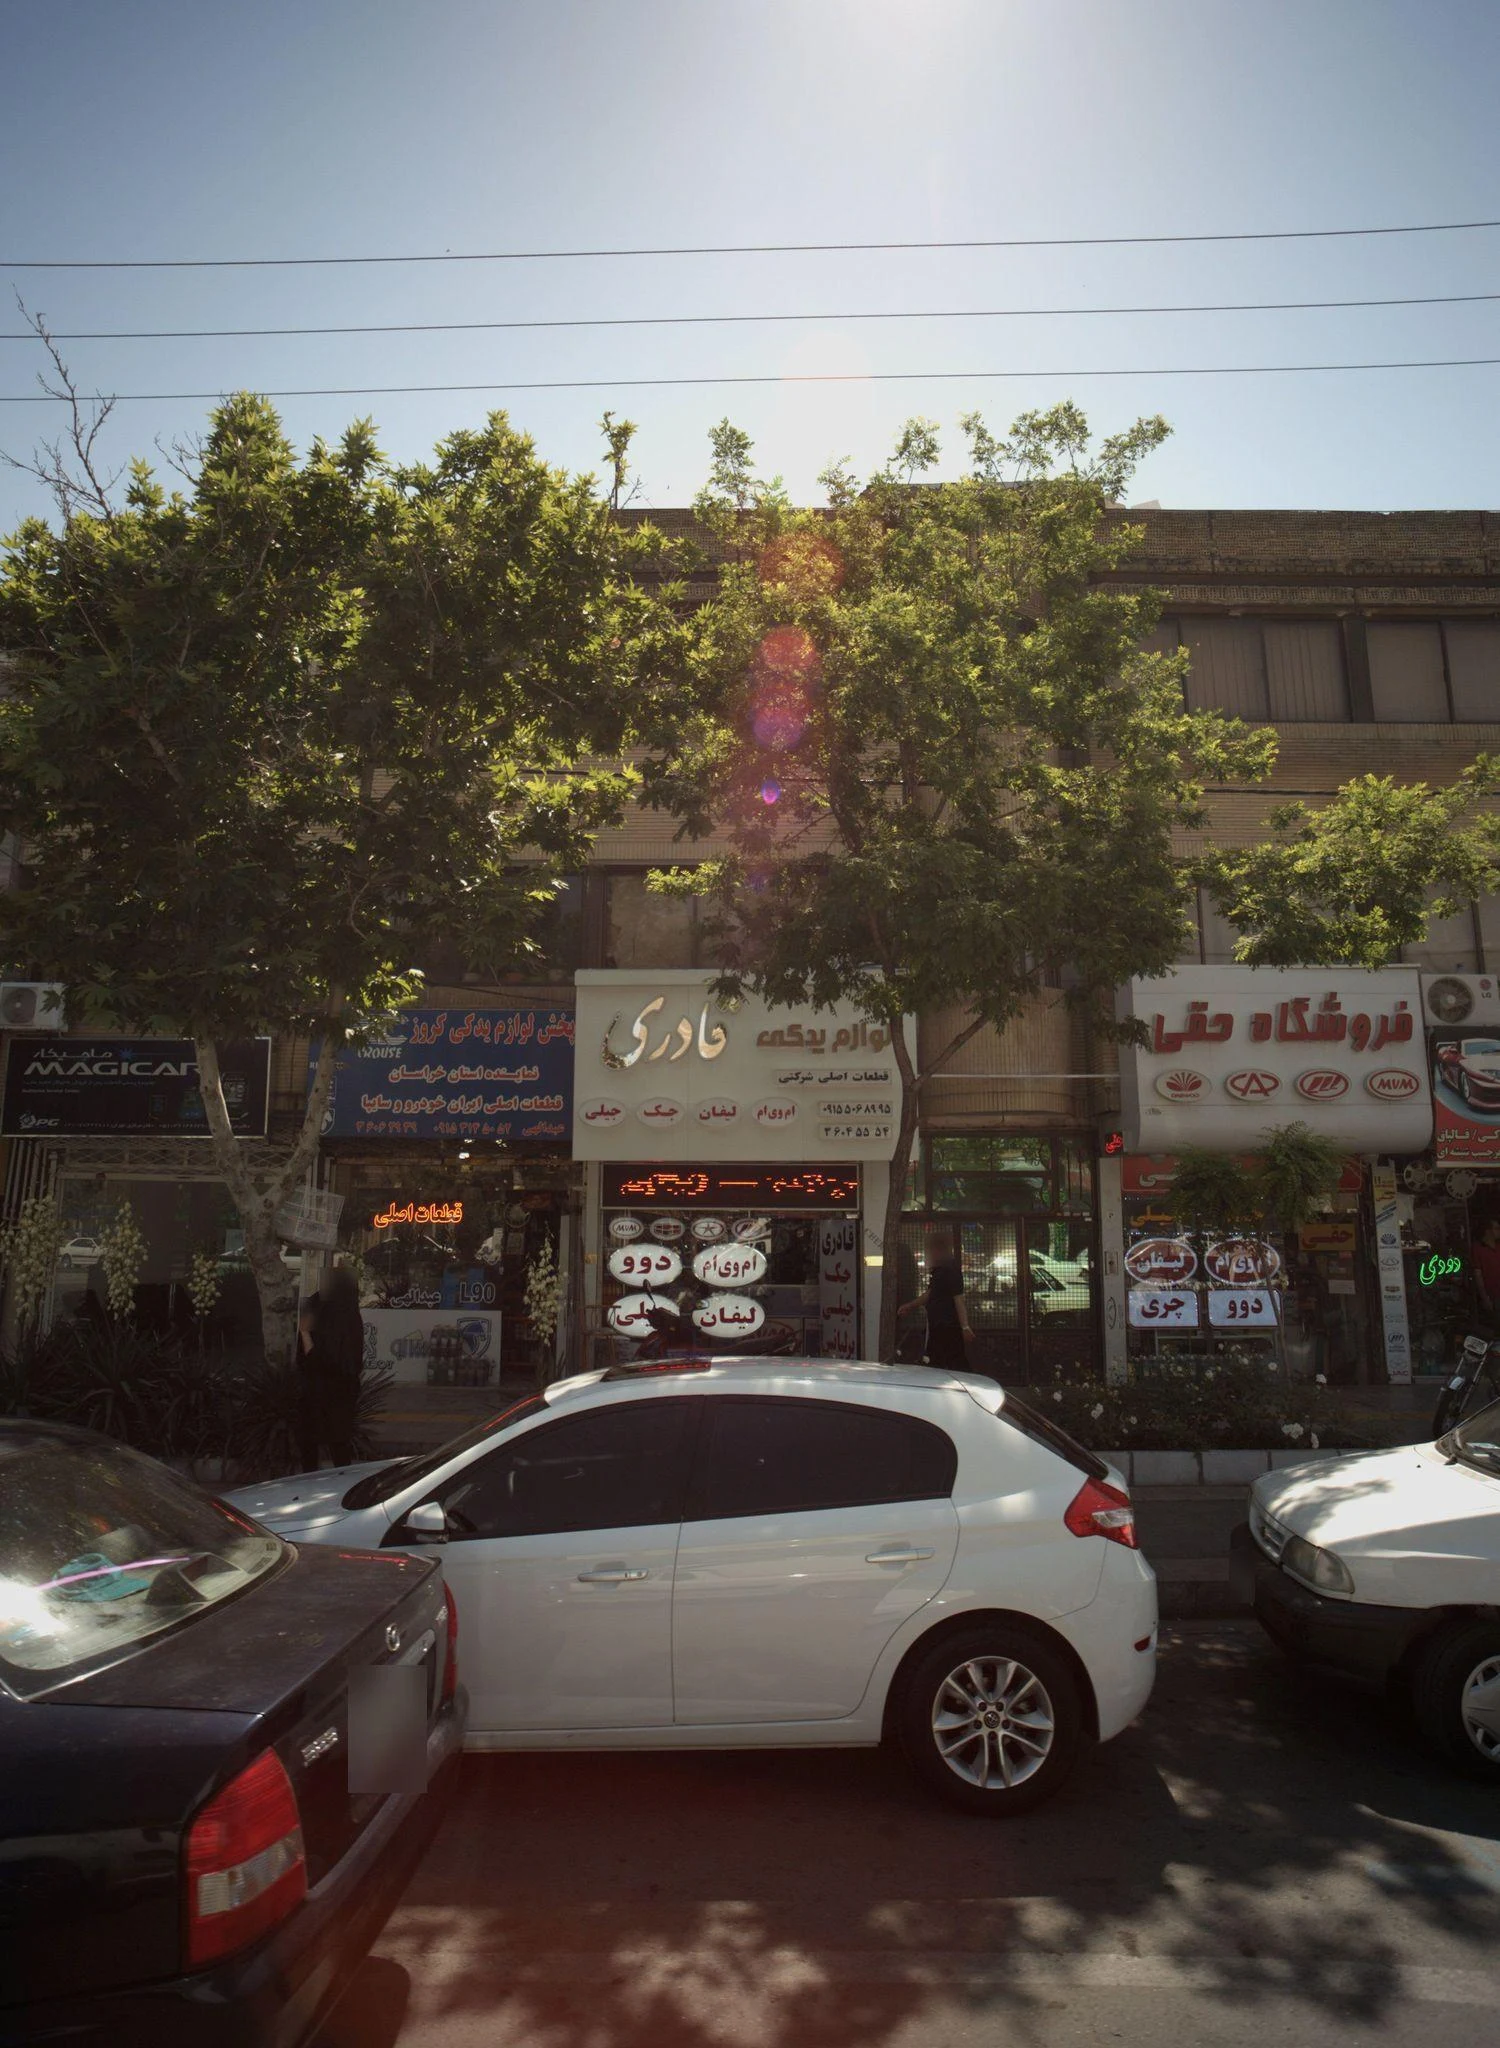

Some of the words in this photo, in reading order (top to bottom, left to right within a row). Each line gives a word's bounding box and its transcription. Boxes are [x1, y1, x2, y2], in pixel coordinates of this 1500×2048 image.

[1481, 991, 1492, 999] LG
[408, 1013, 447, 1044] کروز
[449, 1013, 491, 1044] یدکی
[494, 1012, 537, 1045] لوازم
[1153, 1001, 1234, 1053] حقی
[1248, 991, 1413, 1052] فروشگاه
[757, 1023, 826, 1054] یدکی
[832, 1022, 893, 1053] لوازم
[388, 1065, 446, 1083] خراسان
[448, 1066, 482, 1083] استان
[485, 1066, 539, 1083] نماینده
[778, 1071, 814, 1085] شرکتی
[818, 1071, 847, 1084] اصلی
[852, 1071, 889, 1082] قطعات
[1376, 1078, 1414, 1090] MVM
[361, 1094, 392, 1113] سایپا
[393, 1099, 402, 1113] و
[403, 1094, 446, 1114] خودرو
[447, 1094, 482, 1114] ایران
[483, 1094, 518, 1114] اصلی
[520, 1094, 564, 1112] قطعات
[585, 1103, 621, 1120] جیلی
[643, 1104, 679, 1120] جک
[699, 1104, 736, 1121] لیفان
[757, 1105, 768, 1119] ام
[784, 1104, 795, 1119] ام
[768, 1109, 784, 1119] وی
[373, 1202, 415, 1229] اصلی
[415, 1202, 463, 1223] قطعات
[822, 1225, 854, 1256] قادری
[620, 1255, 672, 1274] دوو
[702, 1254, 718, 1278] ام
[718, 1259, 739, 1278] وی
[742, 1254, 757, 1278] ام
[1136, 1251, 1185, 1273] لیفان
[1420, 1253, 1461, 1285] دودی
[459, 1280, 496, 1303] L90
[700, 1305, 757, 1329] لیفان
[1141, 1297, 1185, 1320] چری
[1227, 1297, 1263, 1319] دوو
